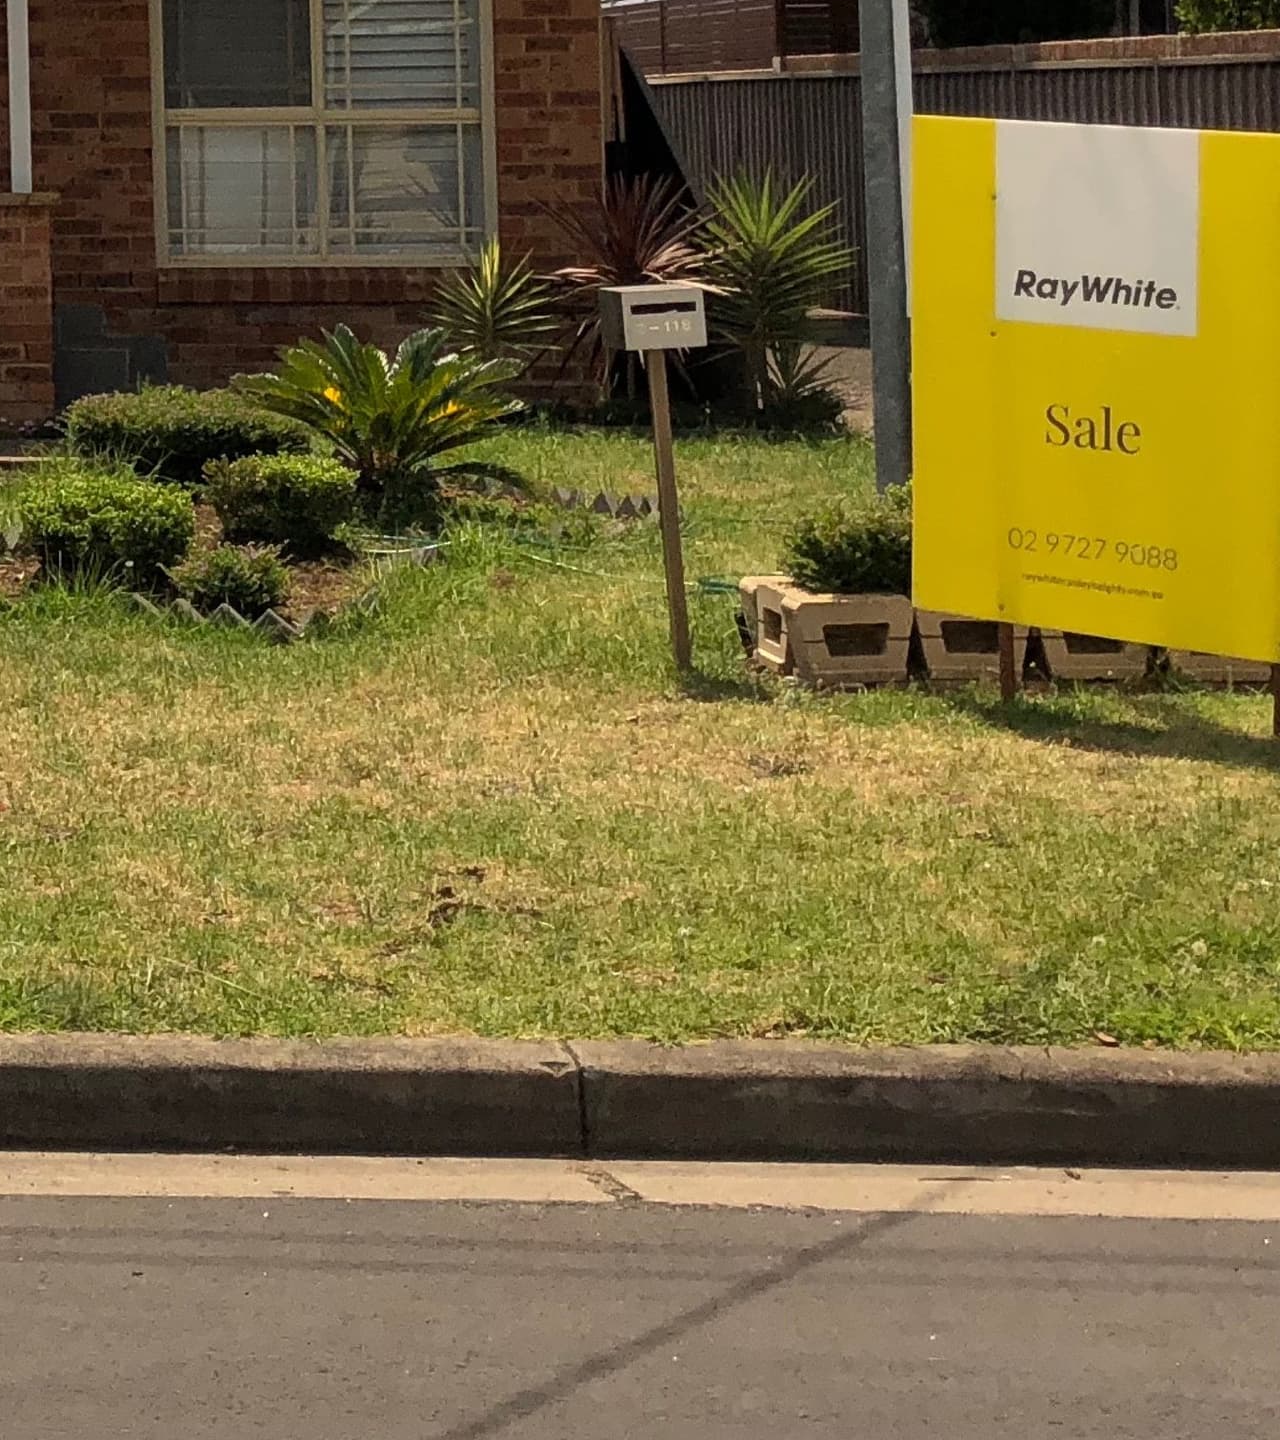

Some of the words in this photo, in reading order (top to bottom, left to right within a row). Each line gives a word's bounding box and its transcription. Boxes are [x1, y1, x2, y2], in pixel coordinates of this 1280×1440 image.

[1045, 403, 1141, 455] Sale
[1007, 527, 1037, 552] 02
[1046, 533, 1107, 559] 9727
[1115, 541, 1178, 571] 9088
